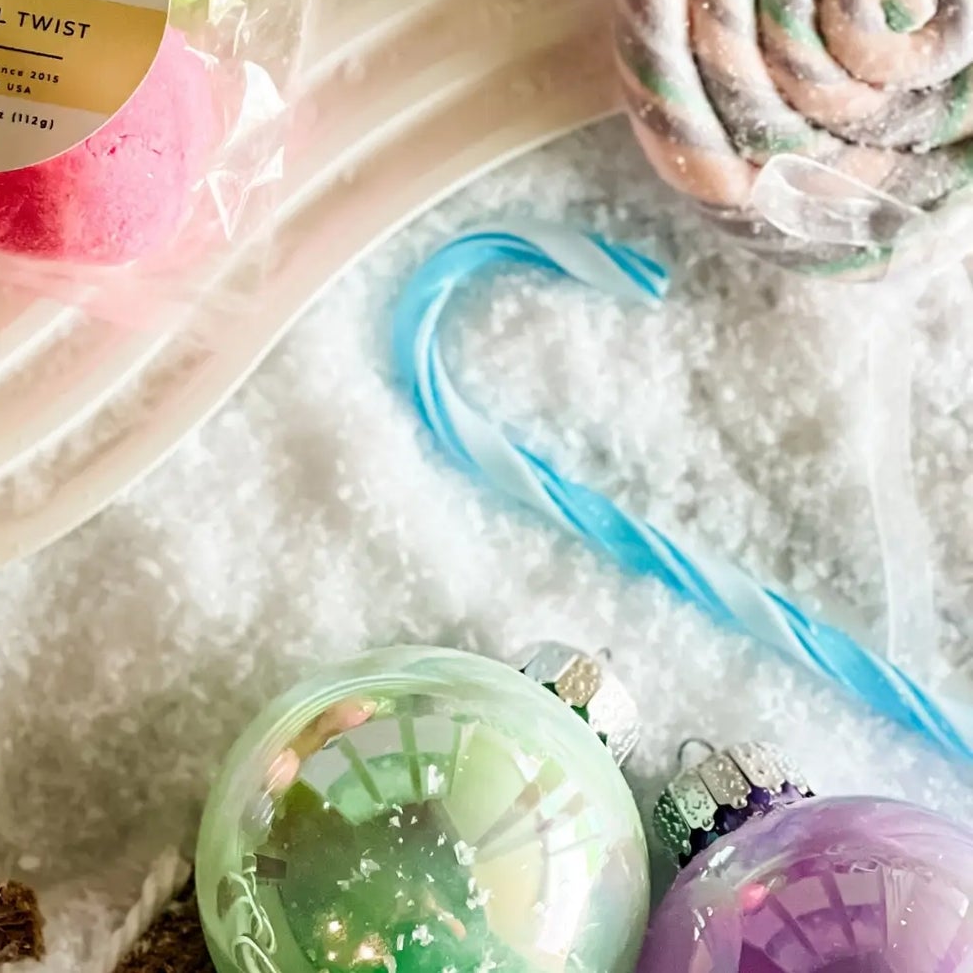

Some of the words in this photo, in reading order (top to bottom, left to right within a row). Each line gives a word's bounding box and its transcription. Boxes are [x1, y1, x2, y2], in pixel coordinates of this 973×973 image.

[17, 12, 91, 39] TWIST
[30, 70, 59, 83] 2015
[7, 83, 32, 94] USA
[11, 112, 55, 130] (112g)
